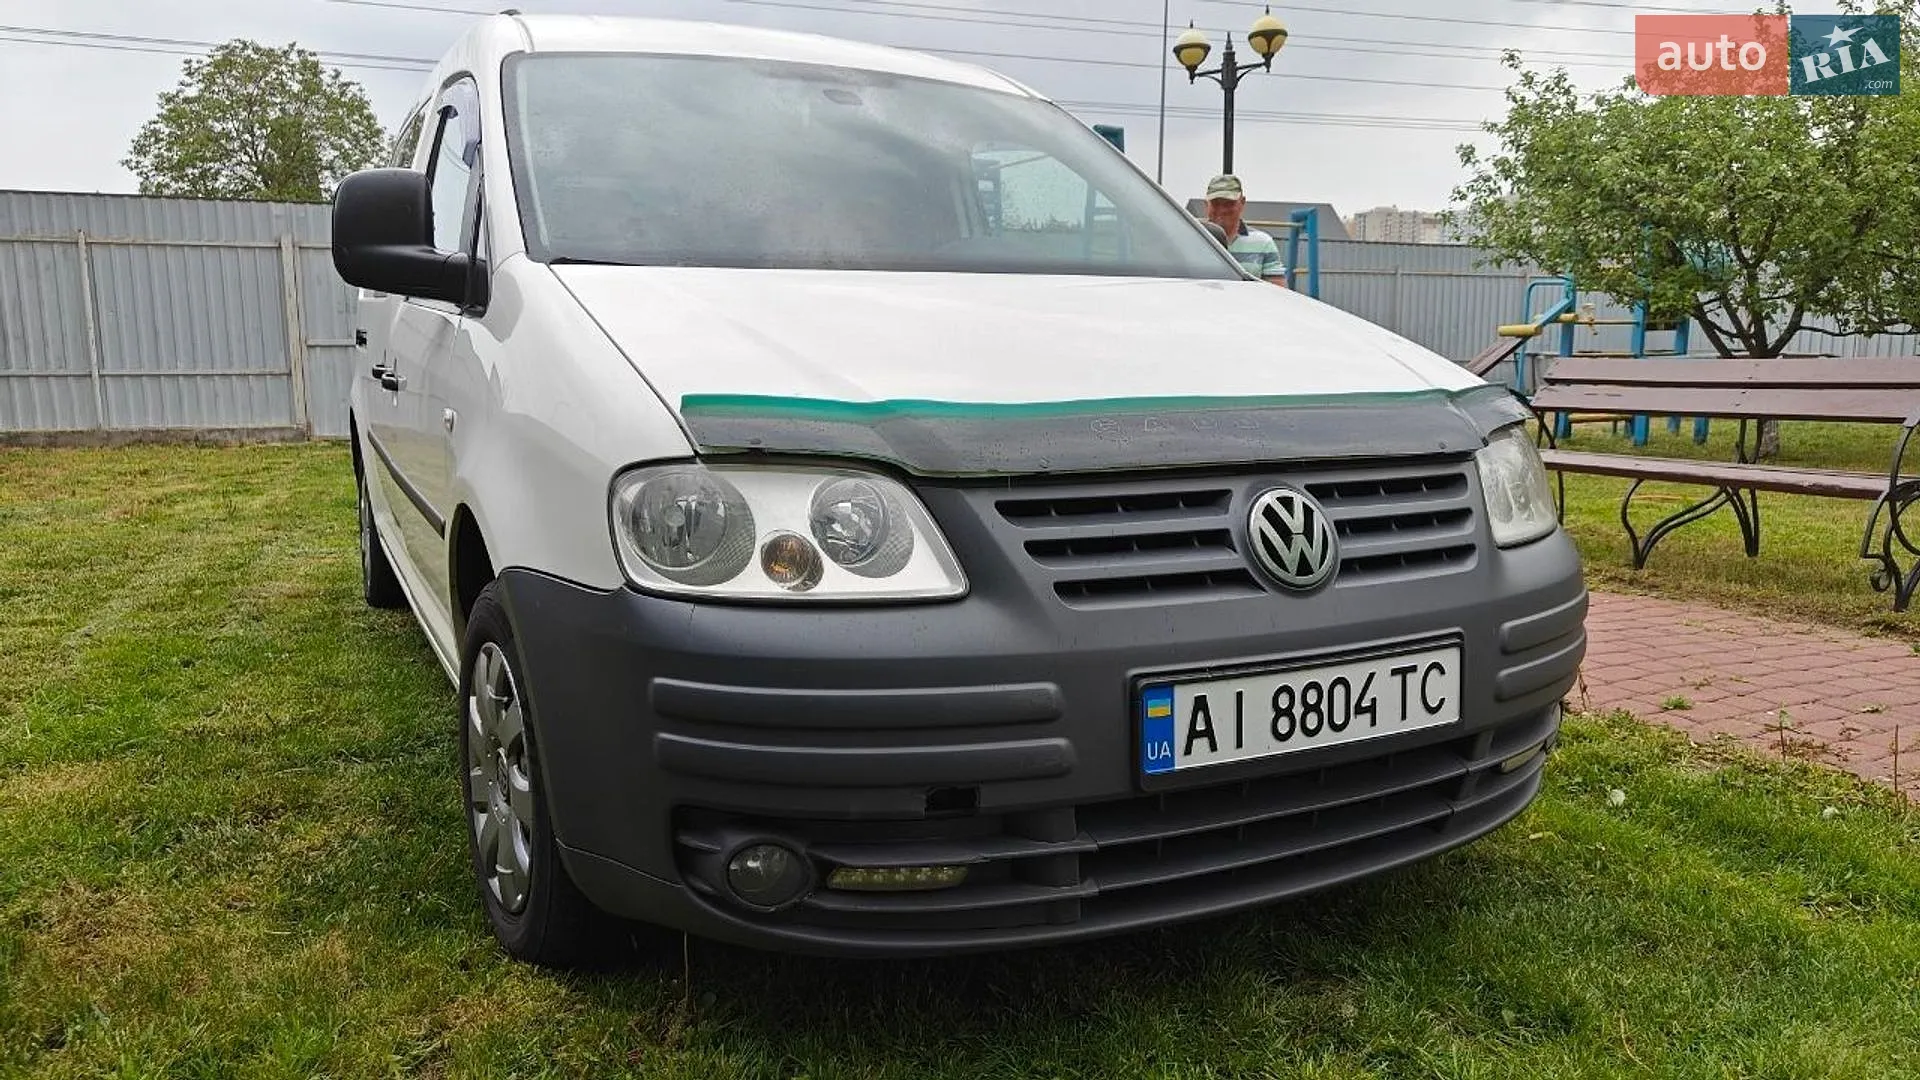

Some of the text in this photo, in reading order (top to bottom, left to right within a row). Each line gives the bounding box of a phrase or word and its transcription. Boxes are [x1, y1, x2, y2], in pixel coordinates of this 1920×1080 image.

[1183, 661, 1446, 756] AI 8804 TC
[1147, 741, 1171, 760] UA
